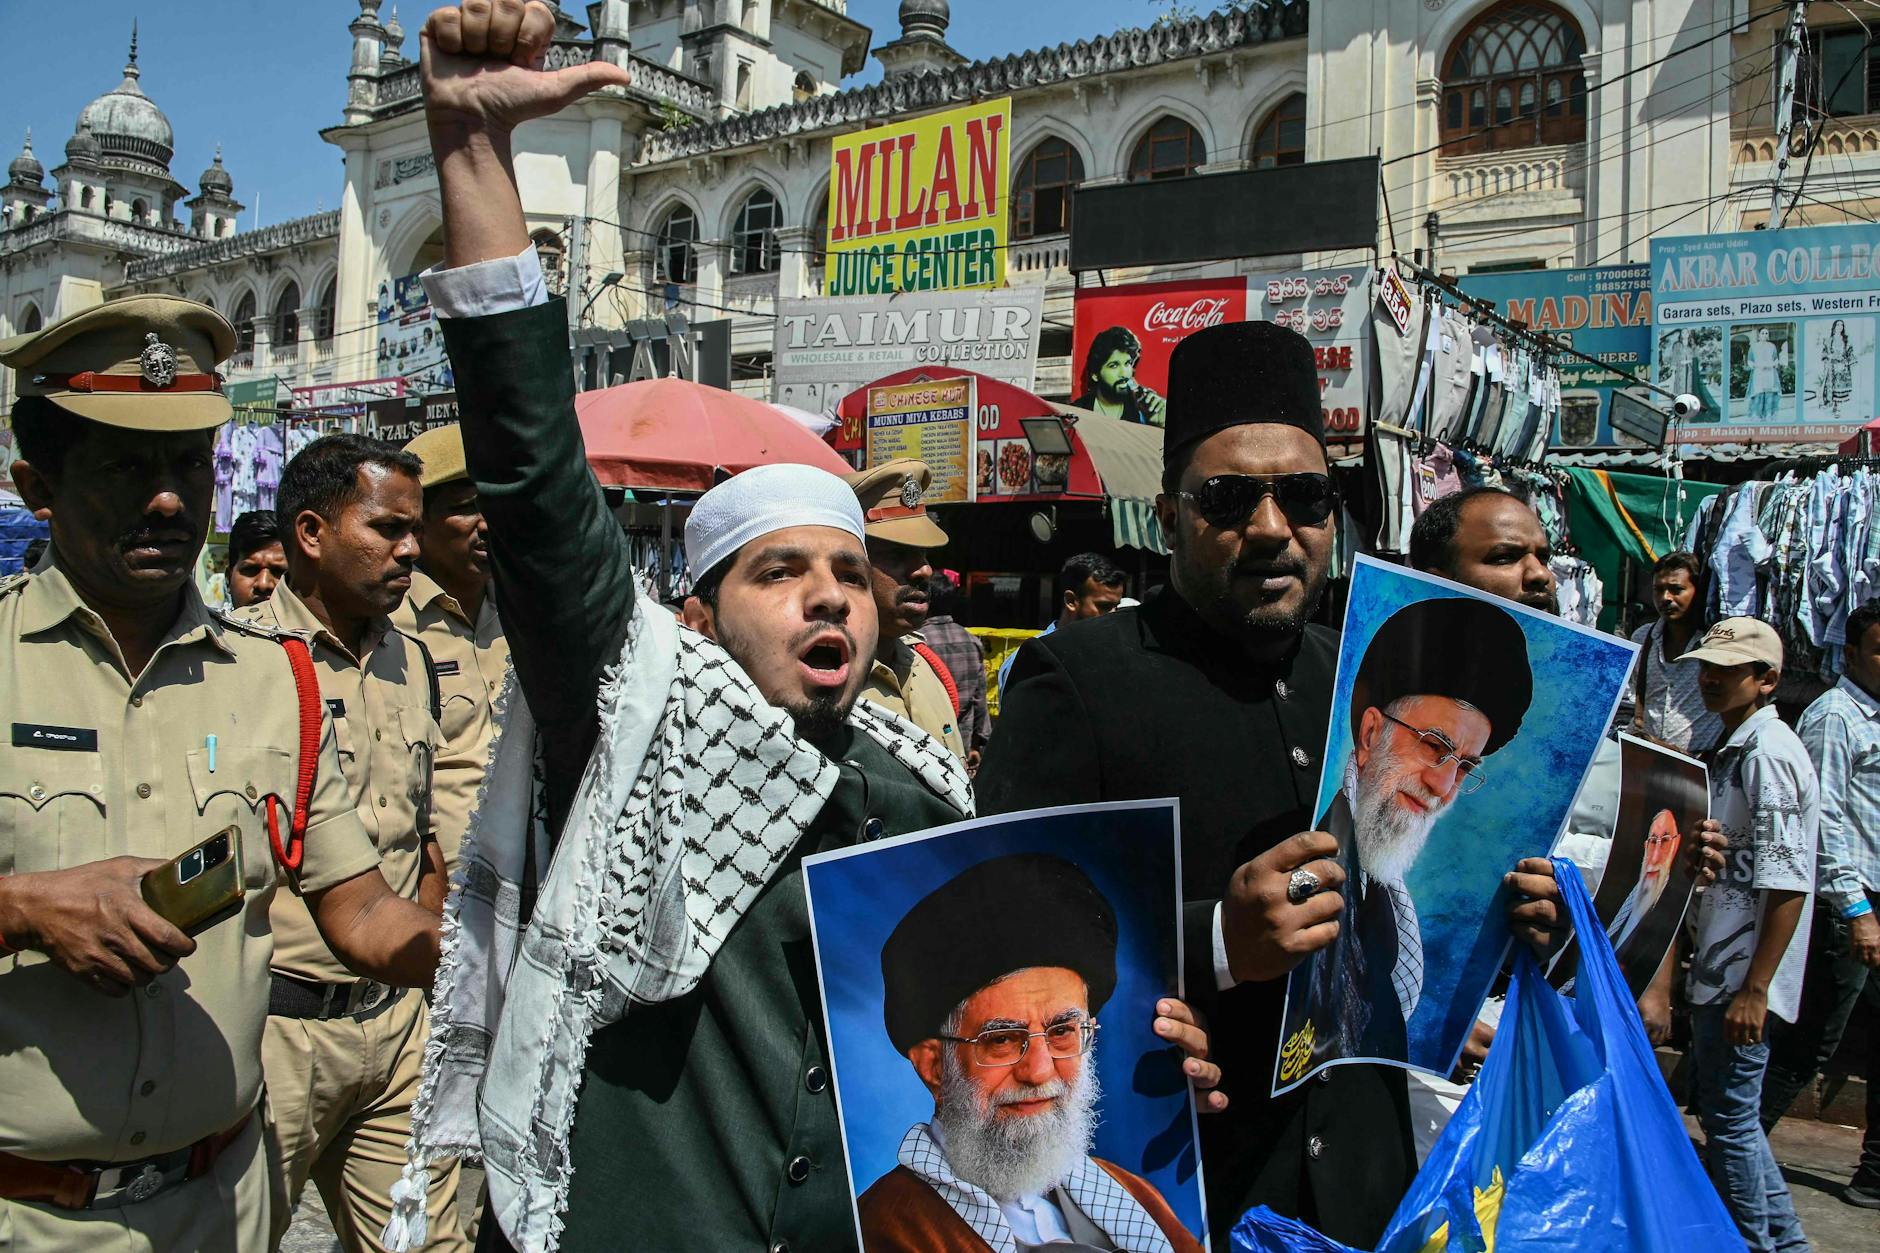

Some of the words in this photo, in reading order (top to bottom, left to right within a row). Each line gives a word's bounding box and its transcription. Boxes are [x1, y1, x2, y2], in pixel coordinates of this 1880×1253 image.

[831, 114, 1003, 242] MILAN
[1727, 239, 1749, 248] Uddin
[830, 243, 896, 296] JUICE
[902, 228, 996, 293] CENTER
[1657, 251, 1759, 293] AKBAR
[1567, 273, 1586, 282] Cell
[1143, 297, 1230, 331] Coca-Cola
[1384, 281, 1408, 325] 350
[1507, 291, 1652, 333] MADINA
[1663, 307, 1702, 320] Garara
[1706, 304, 1735, 317] sets,
[1740, 302, 1773, 315] Plazo
[1777, 299, 1806, 312] sets,
[1811, 296, 1864, 311] Western
[783, 305, 1033, 349] TAIMUR
[572, 331, 703, 393] ILAN
[791, 351, 852, 364] WHOLESALE
[857, 351, 864, 362] &
[869, 349, 905, 362] RETAIL
[916, 342, 1030, 363] COLLECTION
[1314, 346, 1352, 371] ESE
[1597, 351, 1638, 364] HERE
[889, 390, 938, 408] CHINESE
[366, 410, 422, 441] AFZAL'S
[873, 414, 905, 427] MUNNU
[906, 412, 928, 424] MIYA
[930, 408, 965, 421] KEBABS
[979, 404, 1000, 431] OD
[1320, 407, 1360, 430] OOD
[1711, 427, 1753, 437] Makkah
[1759, 425, 1800, 439] Masjid
[1804, 424, 1834, 435] Main
[1840, 424, 1858, 434] Do
[1720, 848, 1754, 883] TS
